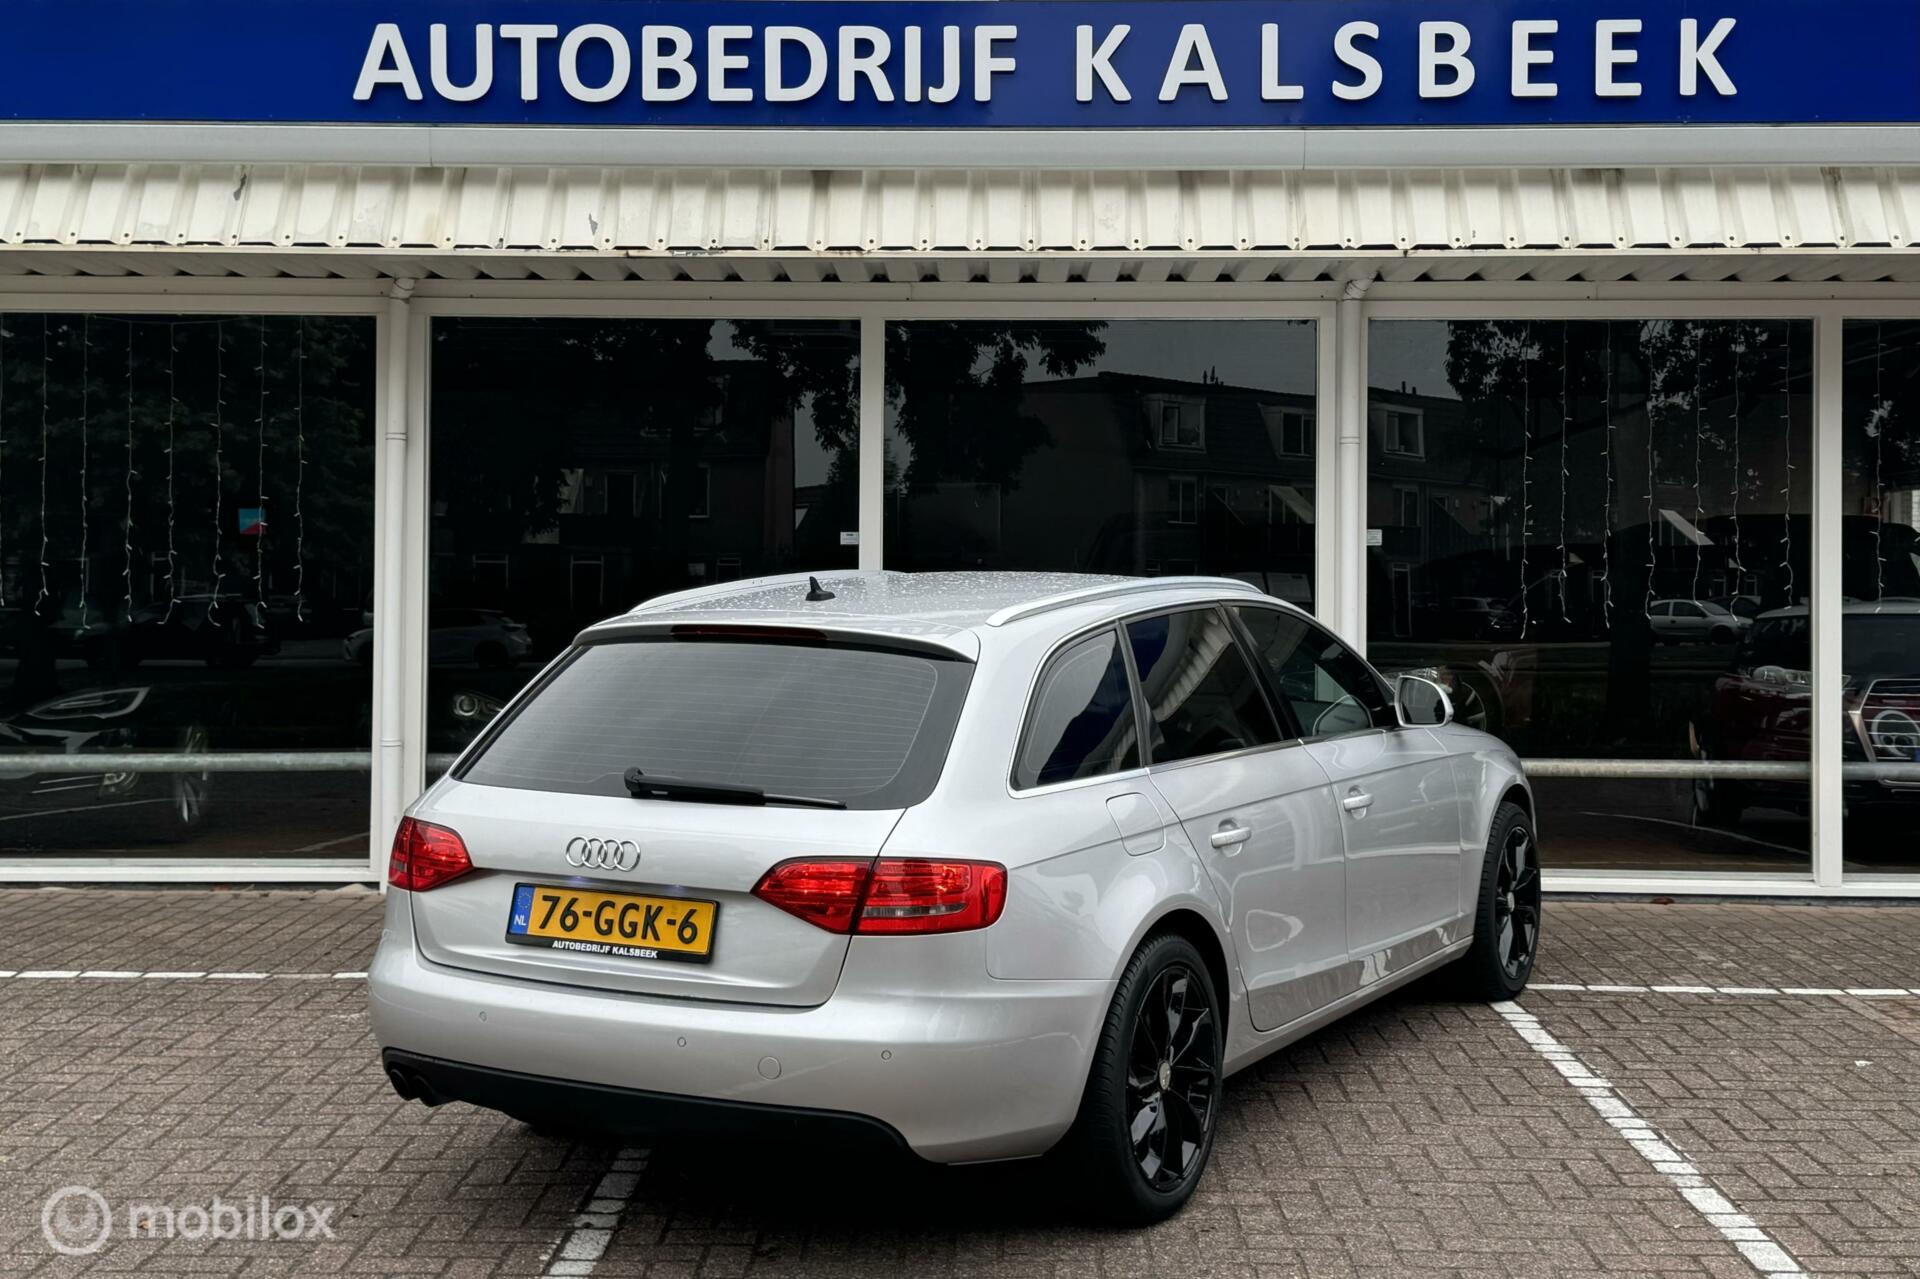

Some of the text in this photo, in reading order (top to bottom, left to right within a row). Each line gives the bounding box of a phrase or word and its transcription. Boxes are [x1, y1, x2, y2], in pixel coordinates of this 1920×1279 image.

[352, 18, 1738, 103] AUTOBEDRIJF KALSBEEK
[513, 894, 699, 945] NL 76-GGK-6
[552, 940, 658, 959] AUTOBEDRIJF KALSBEEK
